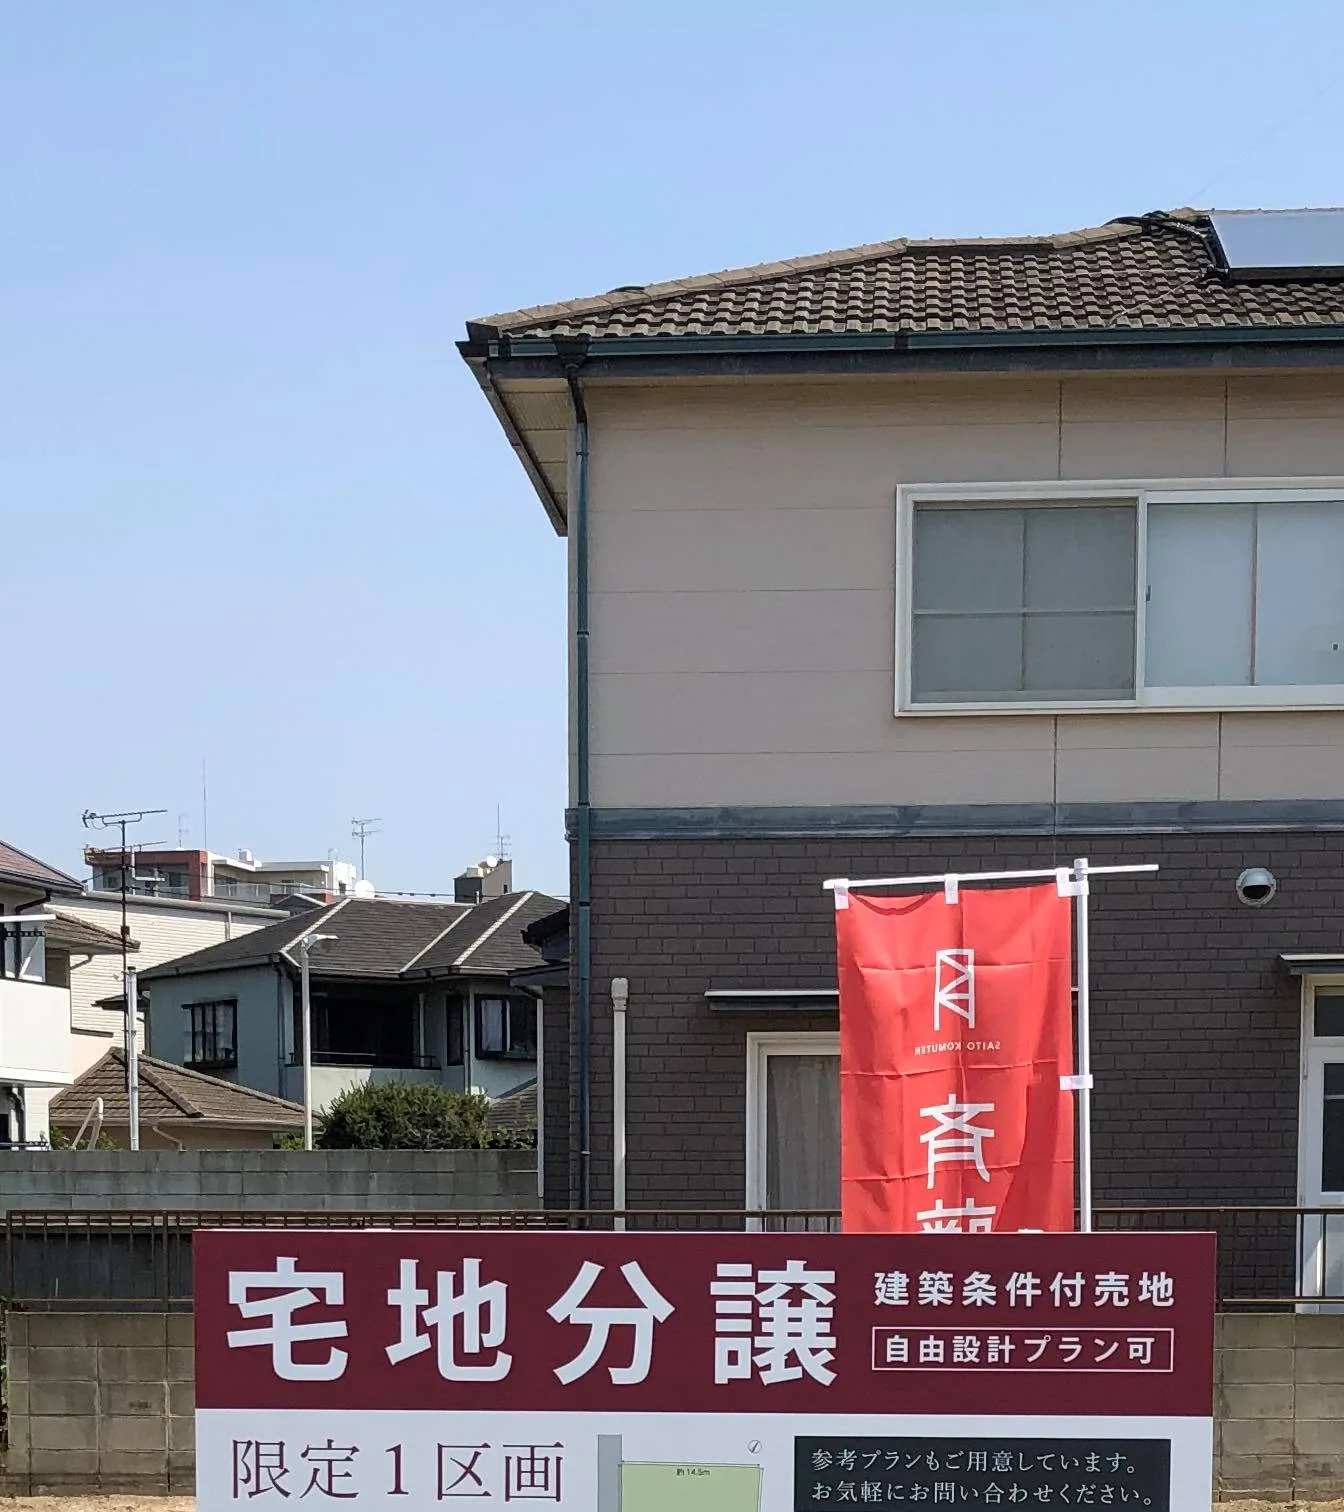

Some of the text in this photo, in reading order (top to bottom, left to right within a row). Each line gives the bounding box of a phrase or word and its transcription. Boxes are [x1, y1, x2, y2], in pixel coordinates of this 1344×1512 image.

[873, 1270, 1175, 1307] 建築条件付売地
[226, 1256, 837, 1386] 宅地分譲
[885, 1334, 1155, 1365] 自由設計プラン可
[232, 1439, 564, 1502] 限定1区画
[811, 1448, 1137, 1474] 参考プランもご用意しています。
[811, 1480, 1152, 1507] お気軽にお問い合わせください。
